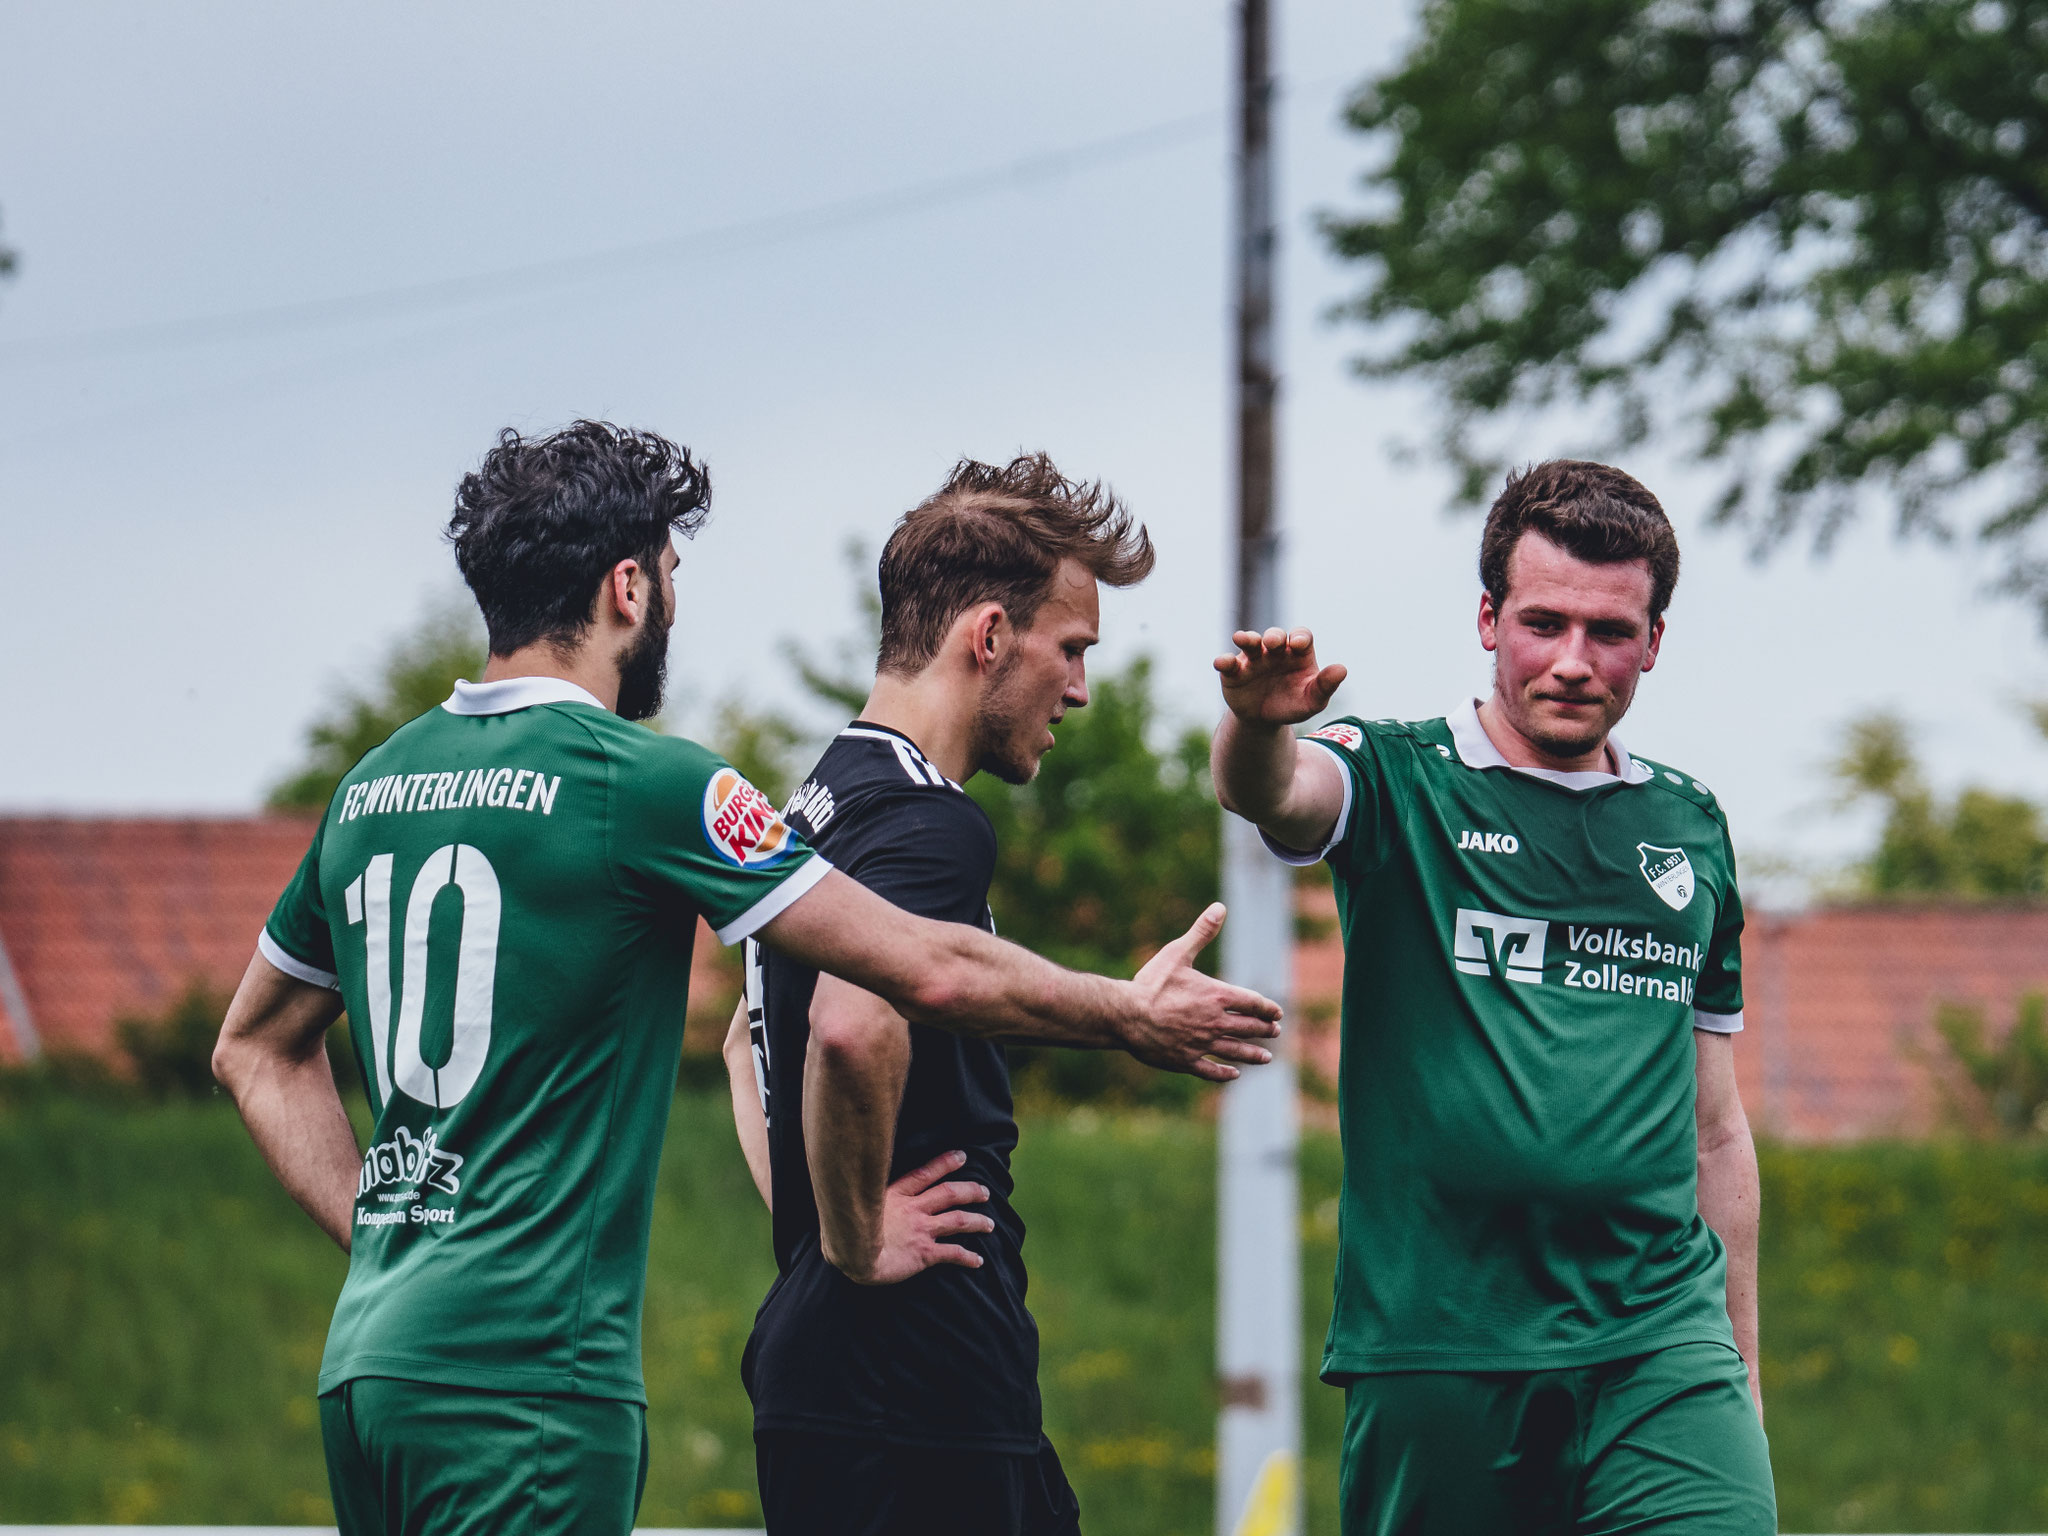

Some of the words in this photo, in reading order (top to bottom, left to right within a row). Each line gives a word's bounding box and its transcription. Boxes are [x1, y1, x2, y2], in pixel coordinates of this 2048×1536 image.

[1457, 830, 1519, 854] JAKO
[1662, 853, 1682, 869] 1931
[1568, 925, 1704, 972] Volksbank
[344, 843, 501, 1109] 10
[1564, 960, 1695, 1006] Zollernalb
[410, 1204, 456, 1226] Sport
